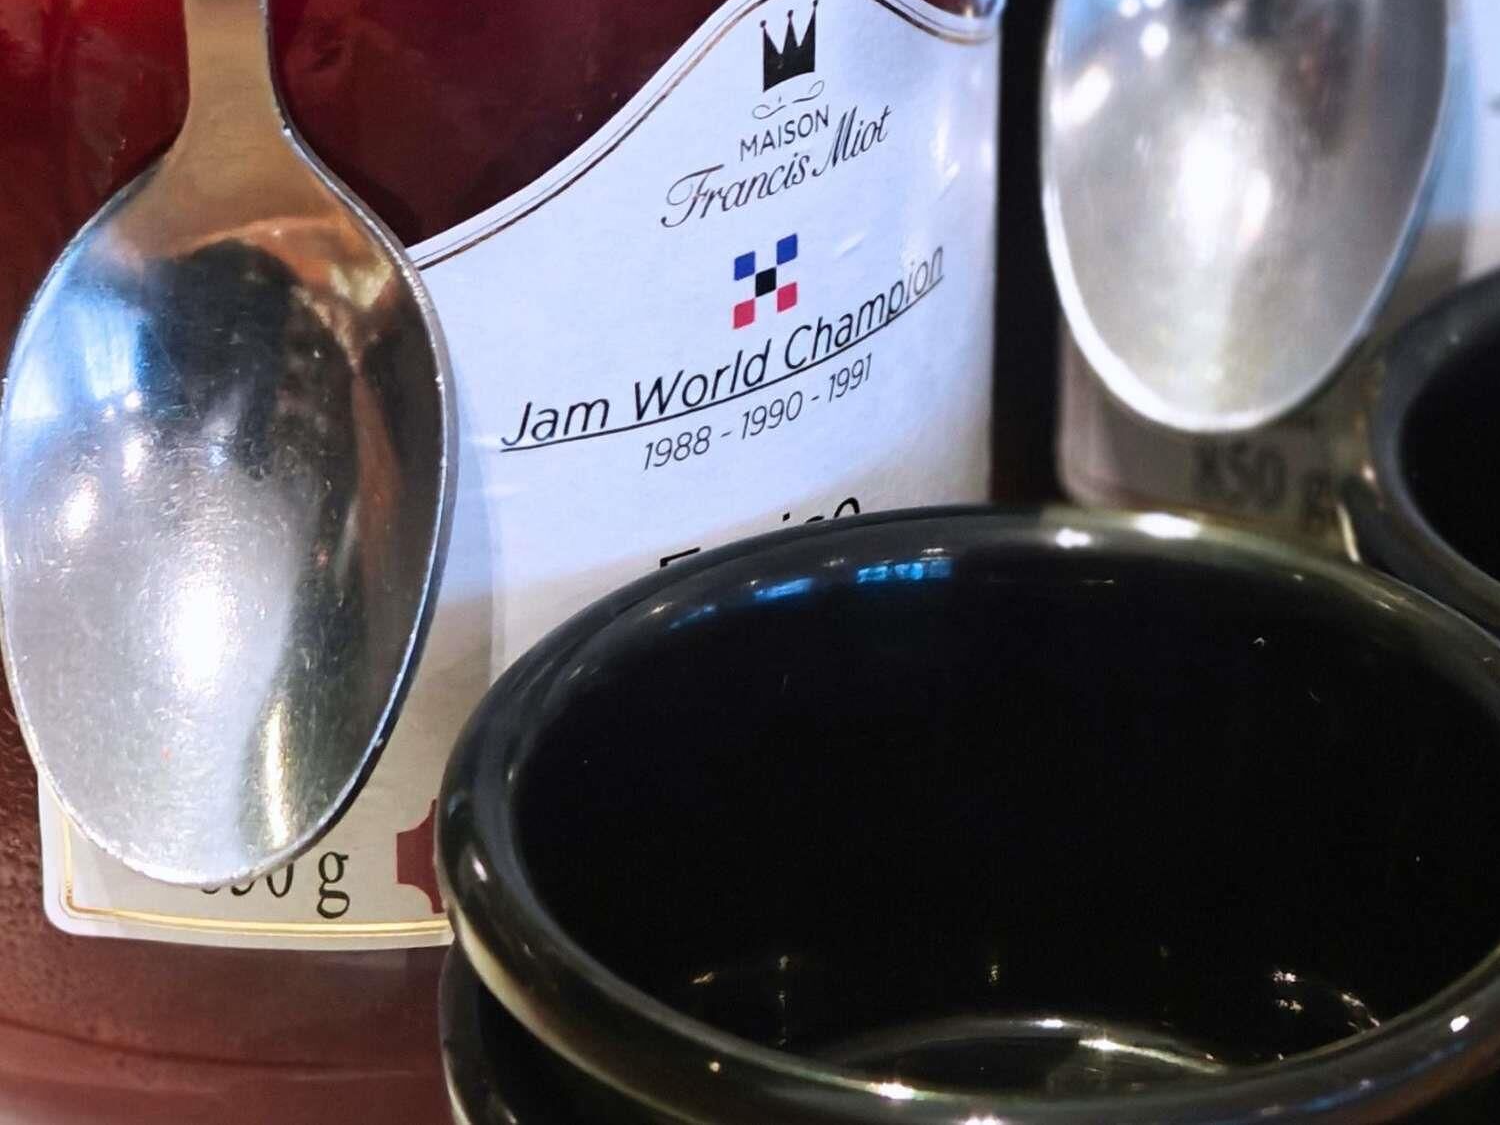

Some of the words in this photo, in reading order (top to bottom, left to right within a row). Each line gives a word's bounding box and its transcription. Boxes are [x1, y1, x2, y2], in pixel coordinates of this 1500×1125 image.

[660, 152, 811, 228] Francis
[811, 104, 892, 178] Miot
[739, 104, 829, 162] MAISON
[500, 399, 610, 447] Jam
[633, 338, 772, 422] World
[783, 245, 944, 372] Champion
[644, 424, 712, 471] 1988
[741, 390, 803, 441] 1990
[828, 353, 873, 404] 1991
[315, 850, 351, 920] g
